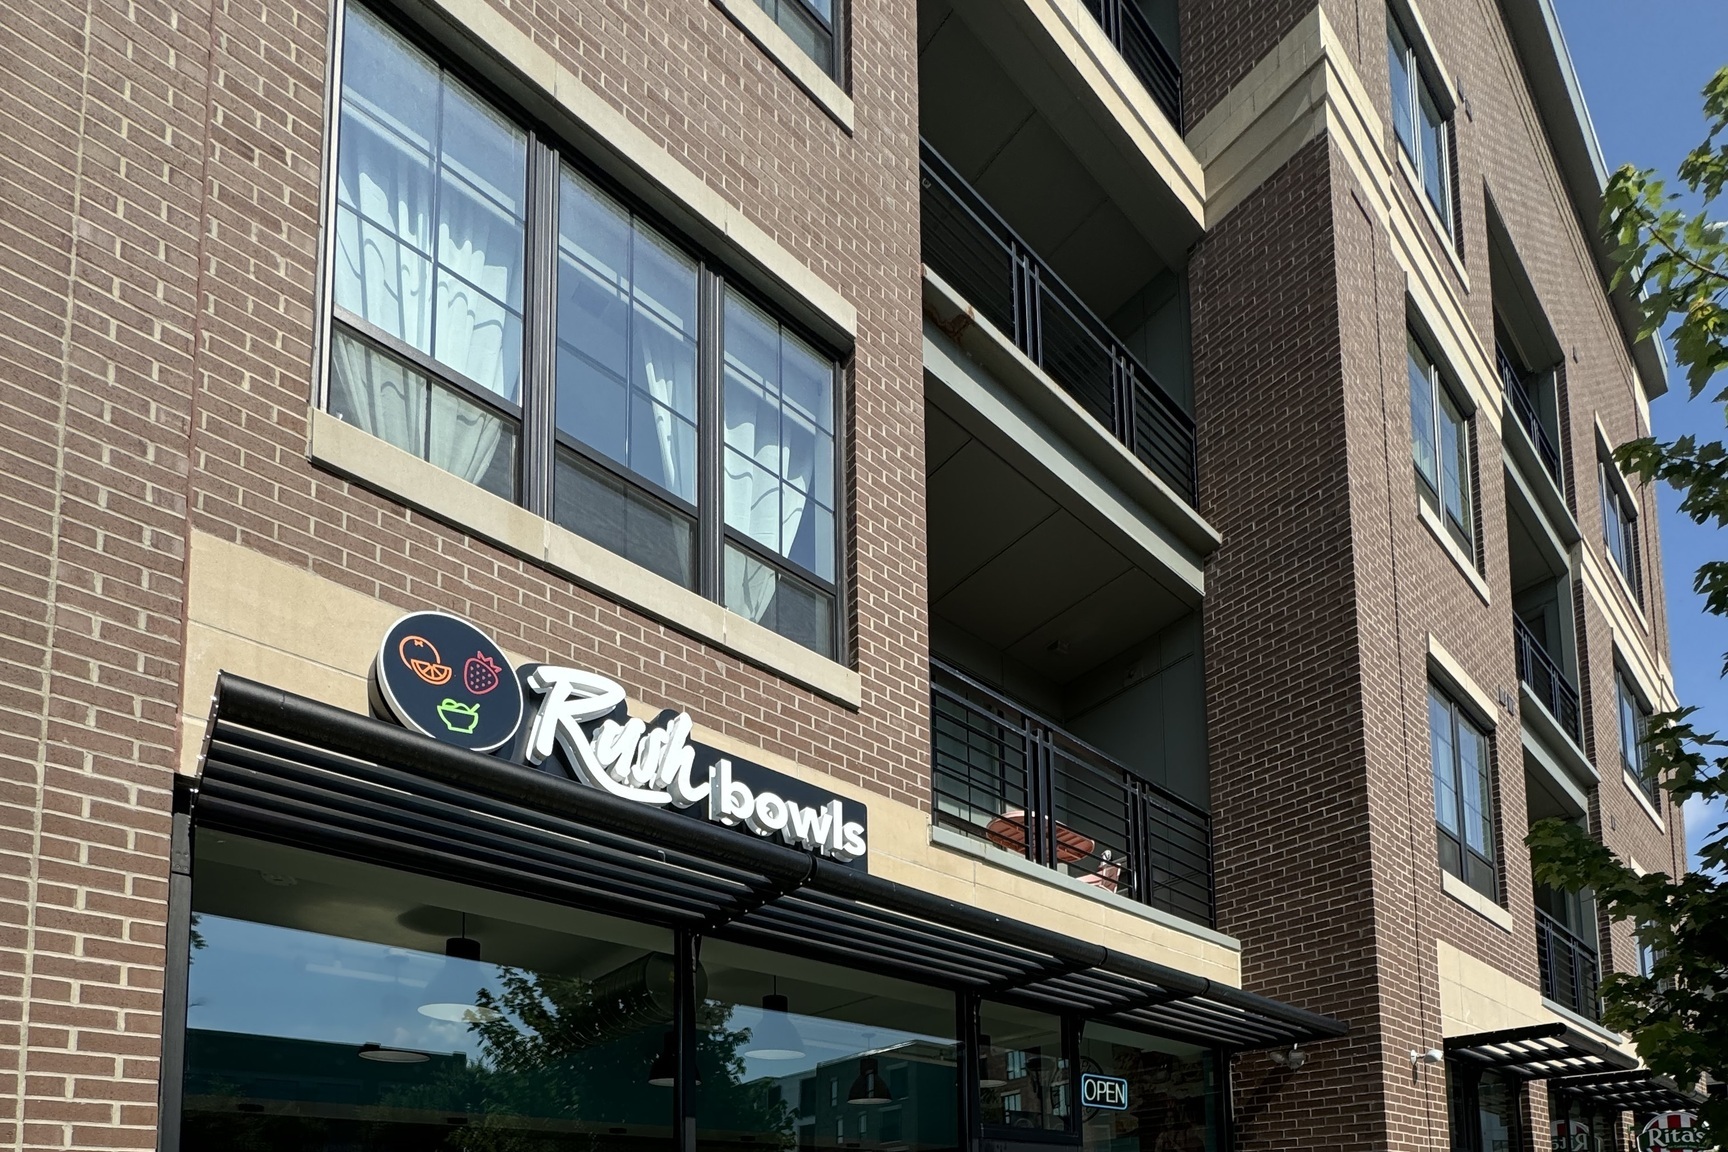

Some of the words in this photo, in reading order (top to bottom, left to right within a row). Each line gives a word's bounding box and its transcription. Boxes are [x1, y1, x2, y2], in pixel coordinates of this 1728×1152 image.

[526, 665, 711, 808] Rush
[709, 757, 867, 862] bowls
[1084, 1078, 1125, 1105] OPEN
